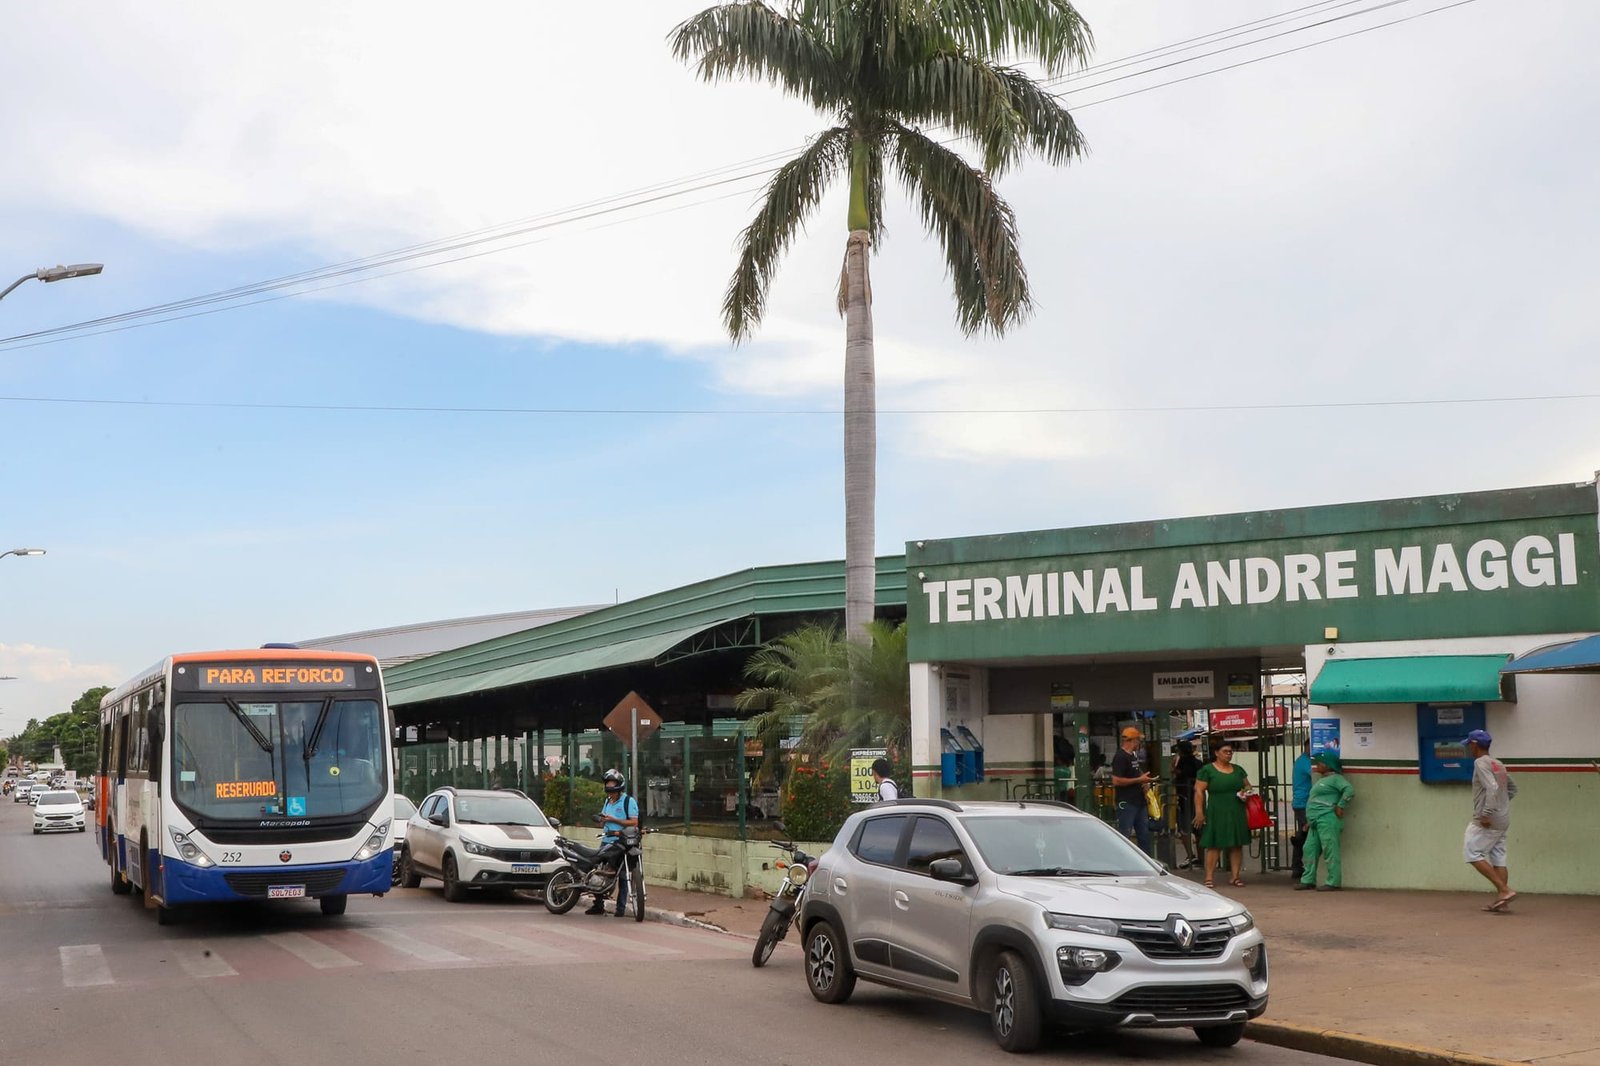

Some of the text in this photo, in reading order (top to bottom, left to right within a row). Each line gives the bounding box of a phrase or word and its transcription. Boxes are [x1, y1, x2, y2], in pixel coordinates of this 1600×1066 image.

[922, 532, 1577, 624] TERMINAL ANDRE MAGGI
[207, 667, 344, 684] PARA REFORCO
[1157, 676, 1210, 686] EMBARQUE
[216, 781, 276, 799] RESERVADO
[222, 852, 242, 863] 252
